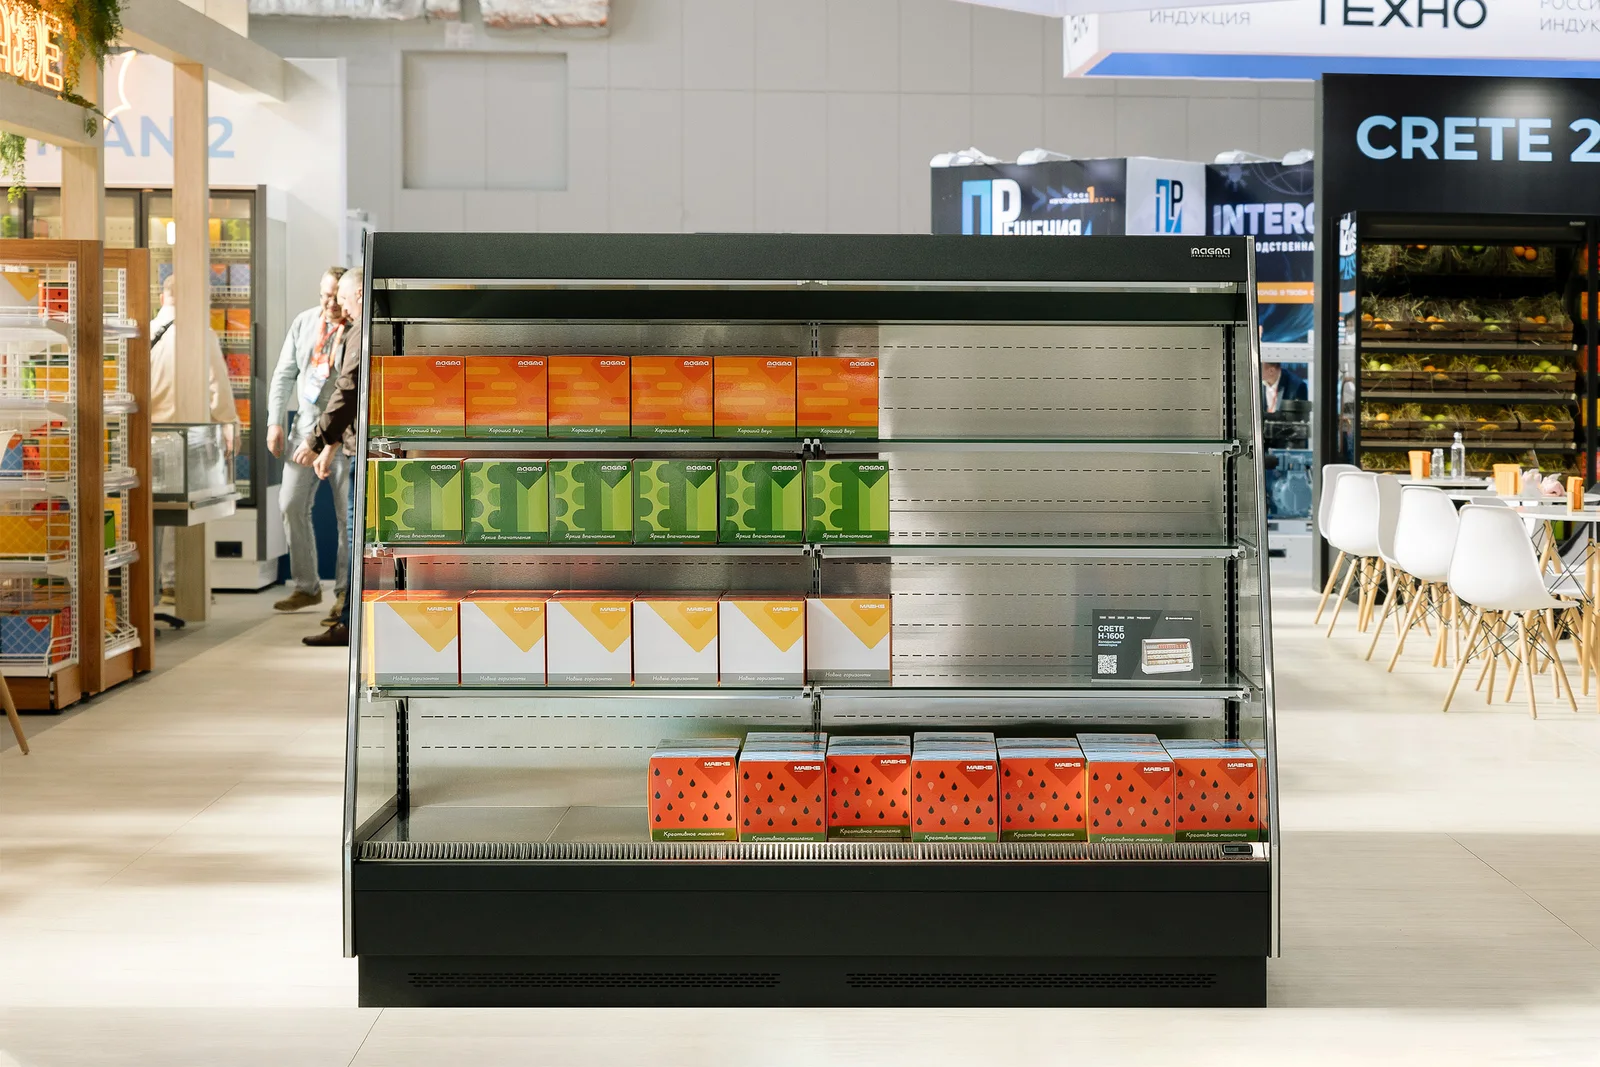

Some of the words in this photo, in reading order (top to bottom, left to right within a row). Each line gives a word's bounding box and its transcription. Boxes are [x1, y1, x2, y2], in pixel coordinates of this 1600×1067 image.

[1150, 10, 1250, 26] ИНДУКЦИЯ
[208, 116, 235, 159] 2
[1356, 115, 1553, 162] CRETE
[1569, 118, 1600, 162] 2
